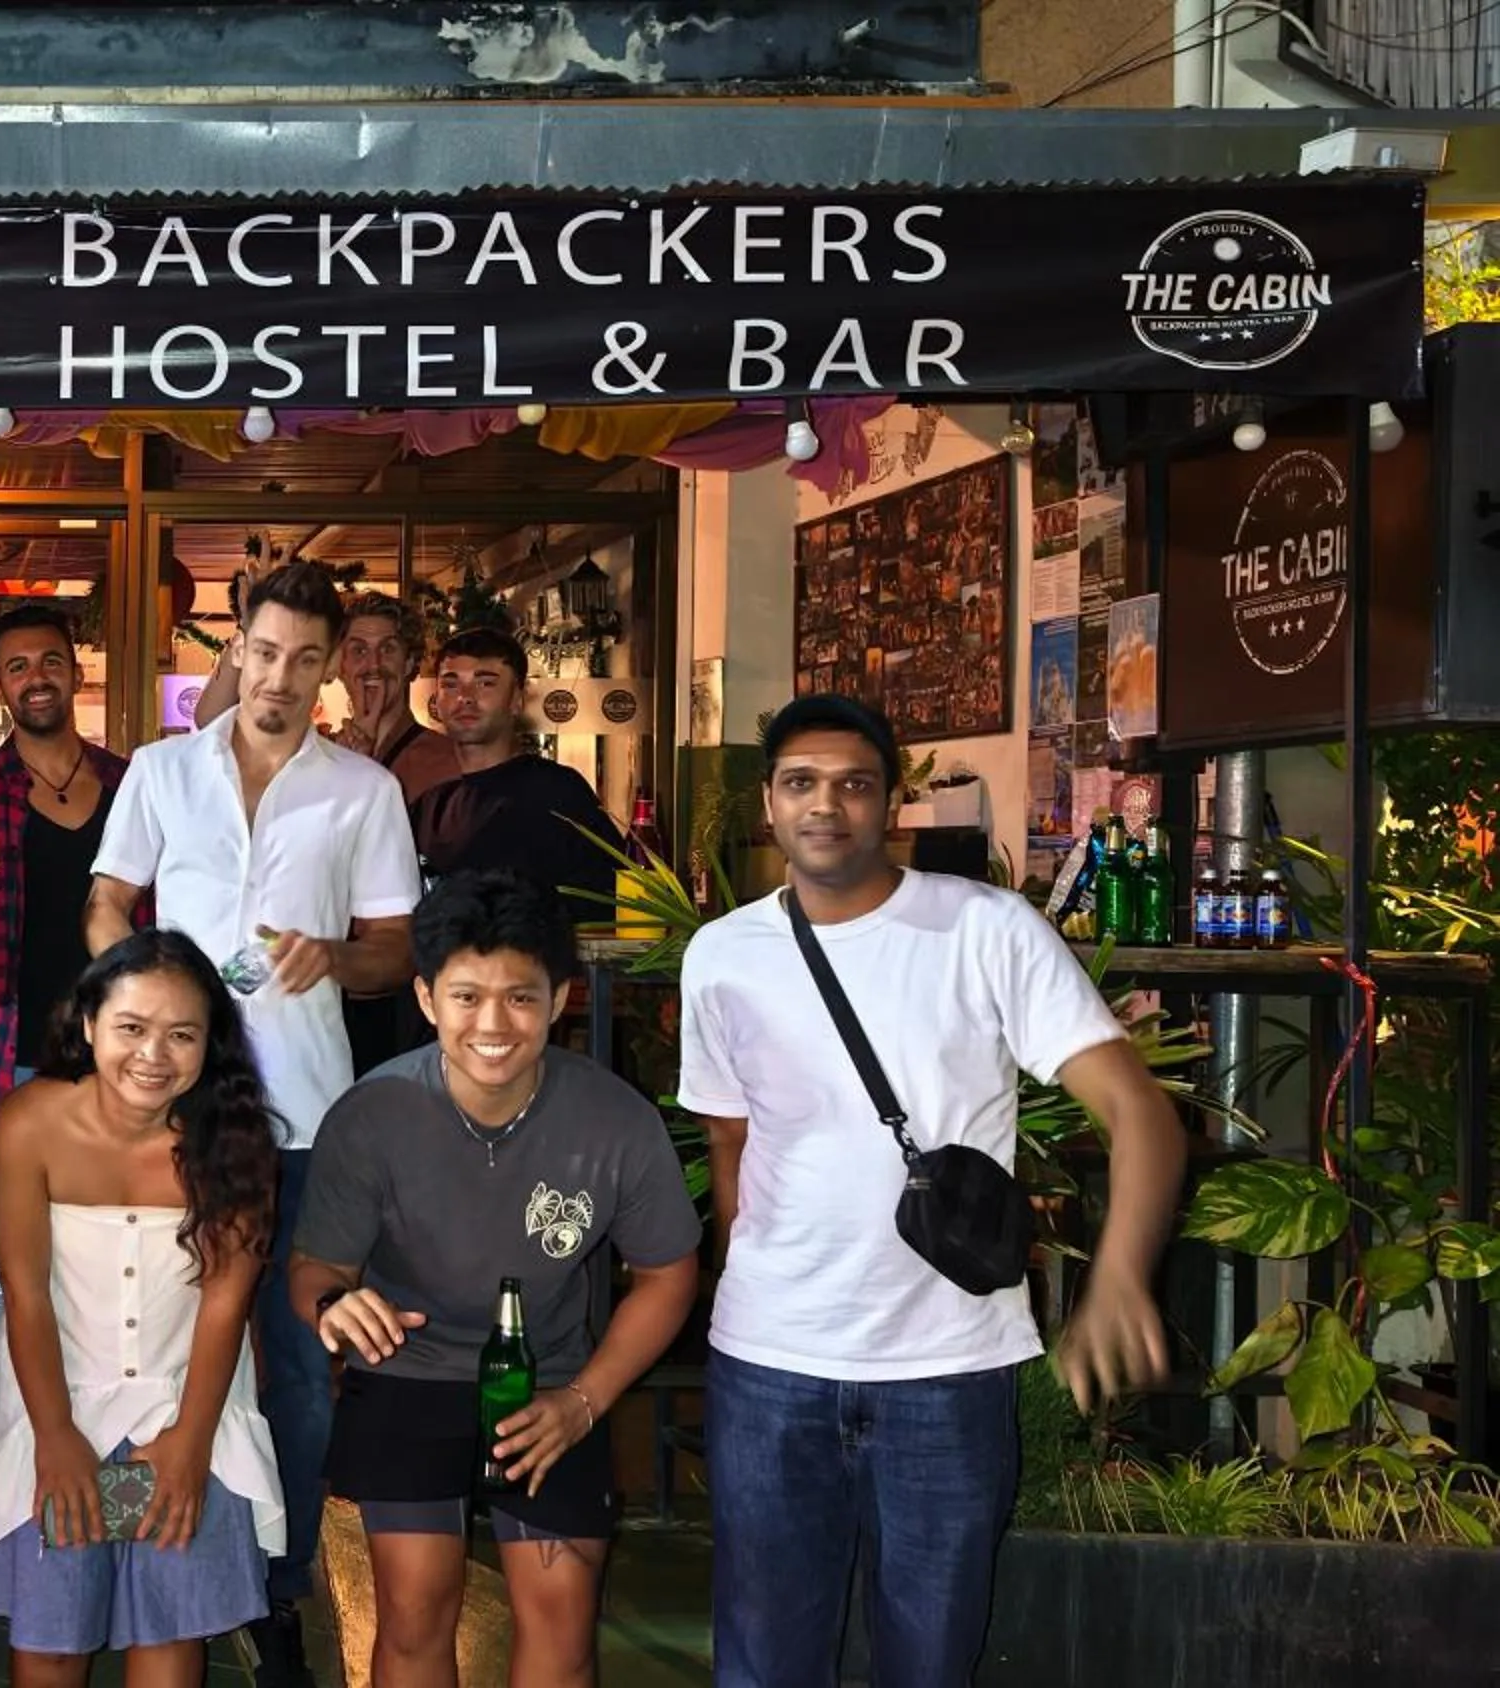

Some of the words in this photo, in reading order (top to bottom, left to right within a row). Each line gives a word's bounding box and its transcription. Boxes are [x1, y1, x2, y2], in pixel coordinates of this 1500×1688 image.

[61, 204, 948, 287] BACKPACKERS
[1193, 223, 1257, 237] PROUDLY
[1121, 272, 1197, 311] THE
[1207, 273, 1333, 312] CABIN
[58, 324, 534, 399] HOSTEL
[591, 320, 667, 395] &
[728, 318, 968, 392] BAR
[1220, 545, 1271, 599] THE
